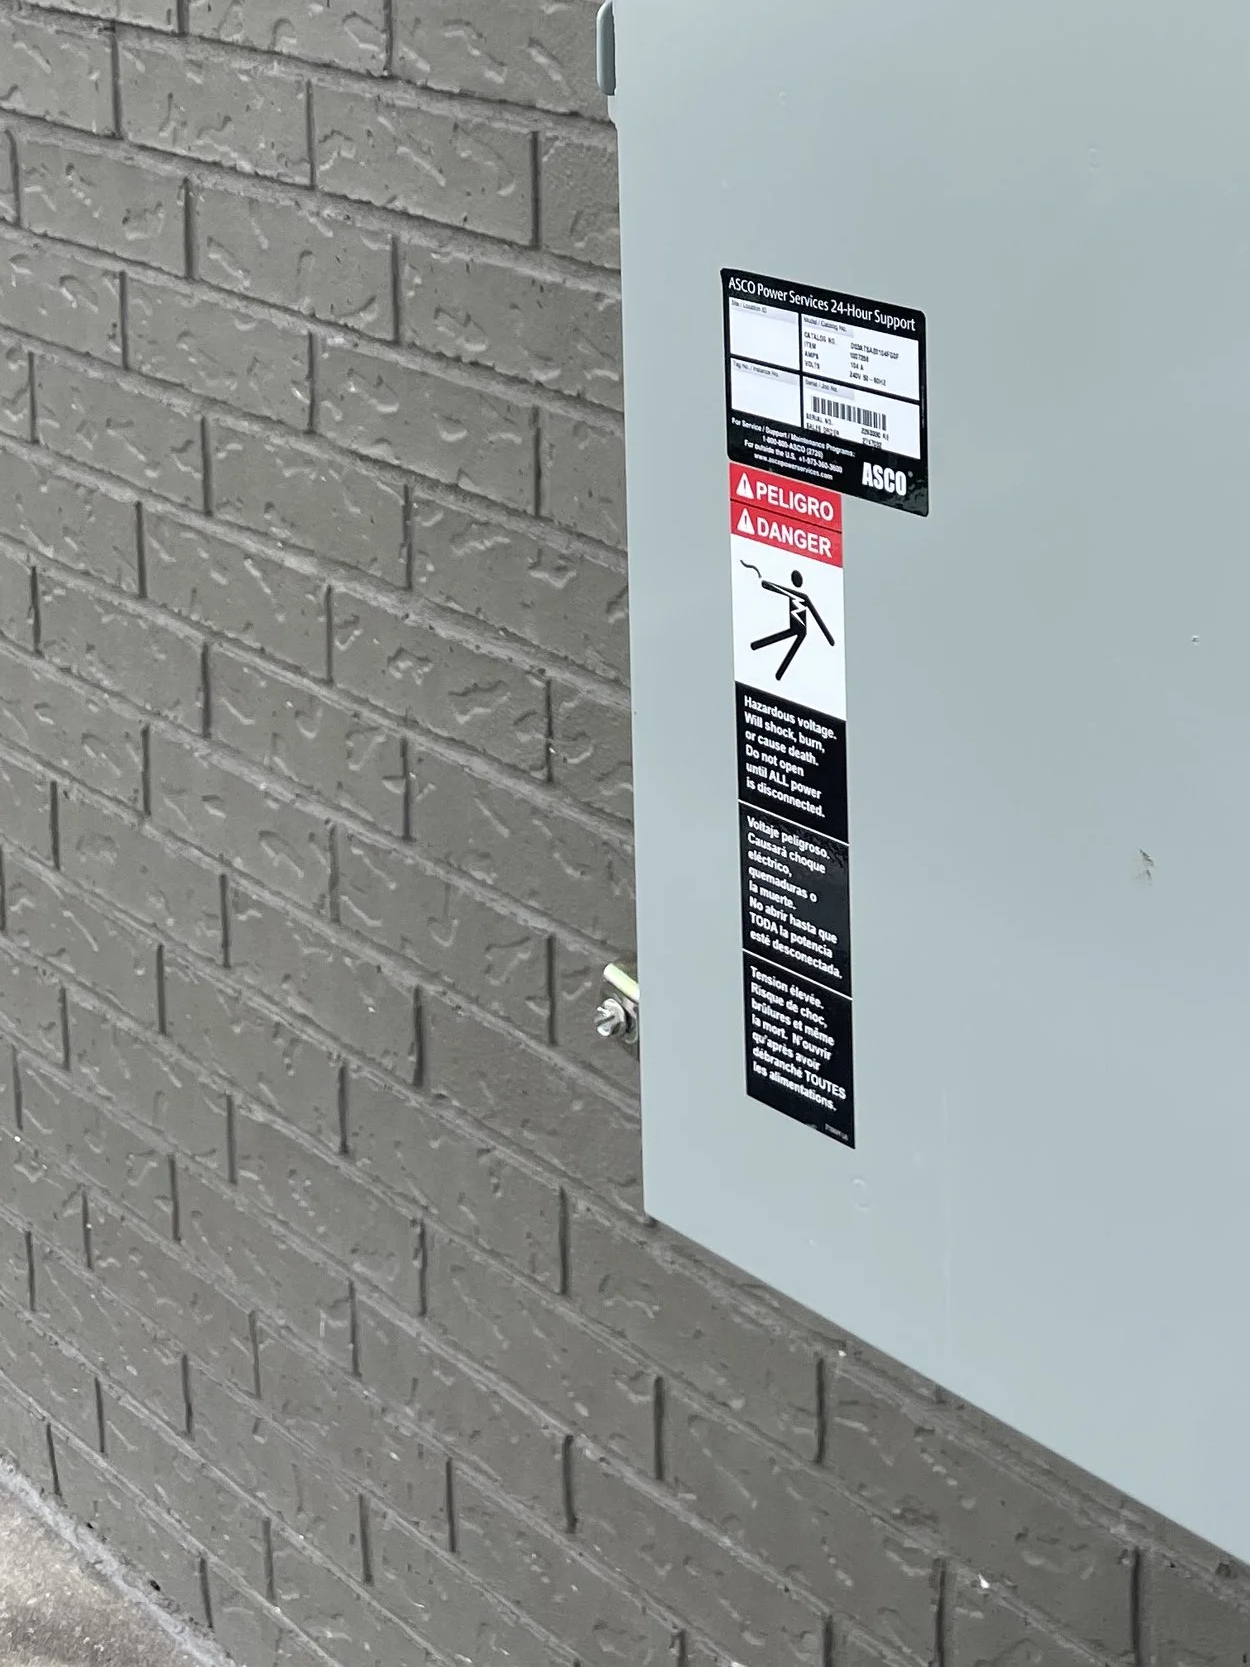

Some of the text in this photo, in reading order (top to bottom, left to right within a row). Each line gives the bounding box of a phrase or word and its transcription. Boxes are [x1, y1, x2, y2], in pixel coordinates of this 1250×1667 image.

[728, 276, 915, 331] ASCO Power Services 24-Hour Support
[862, 461, 907, 497] ASCO
[755, 480, 834, 521] PELIGRO
[756, 516, 833, 558] DANGER
[744, 695, 837, 739] Hazardous voltage.
[744, 711, 825, 753] Will shock, burn,
[745, 730, 818, 766] or cause death.
[745, 743, 804, 776] Do not open
[745, 762, 821, 799] until ALL power
[746, 776, 825, 817] is disconnected.
[746, 815, 830, 859] Voltaje peligroso.
[747, 832, 825, 873] Causará choque
[747, 849, 792, 877] eléctrico,
[748, 866, 817, 902] quemaduras o
[749, 879, 796, 909] la muerte.
[749, 895, 837, 943] No abrir hasta que
[749, 911, 832, 958] TODA la potencia
[750, 930, 842, 979] esté desconectada.
[750, 965, 824, 1009] Tension élevée.
[751, 981, 827, 1028] Risque de choc,
[751, 1013, 761, 1027] la
[762, 1020, 788, 1039] mort.
[792, 1019, 803, 1031] et
[804, 1025, 834, 1046] même
[752, 1031, 820, 1070] qu'après avoir
[752, 1046, 846, 1099] débranché TOUTES
[753, 1060, 836, 1111] les alimentations.
